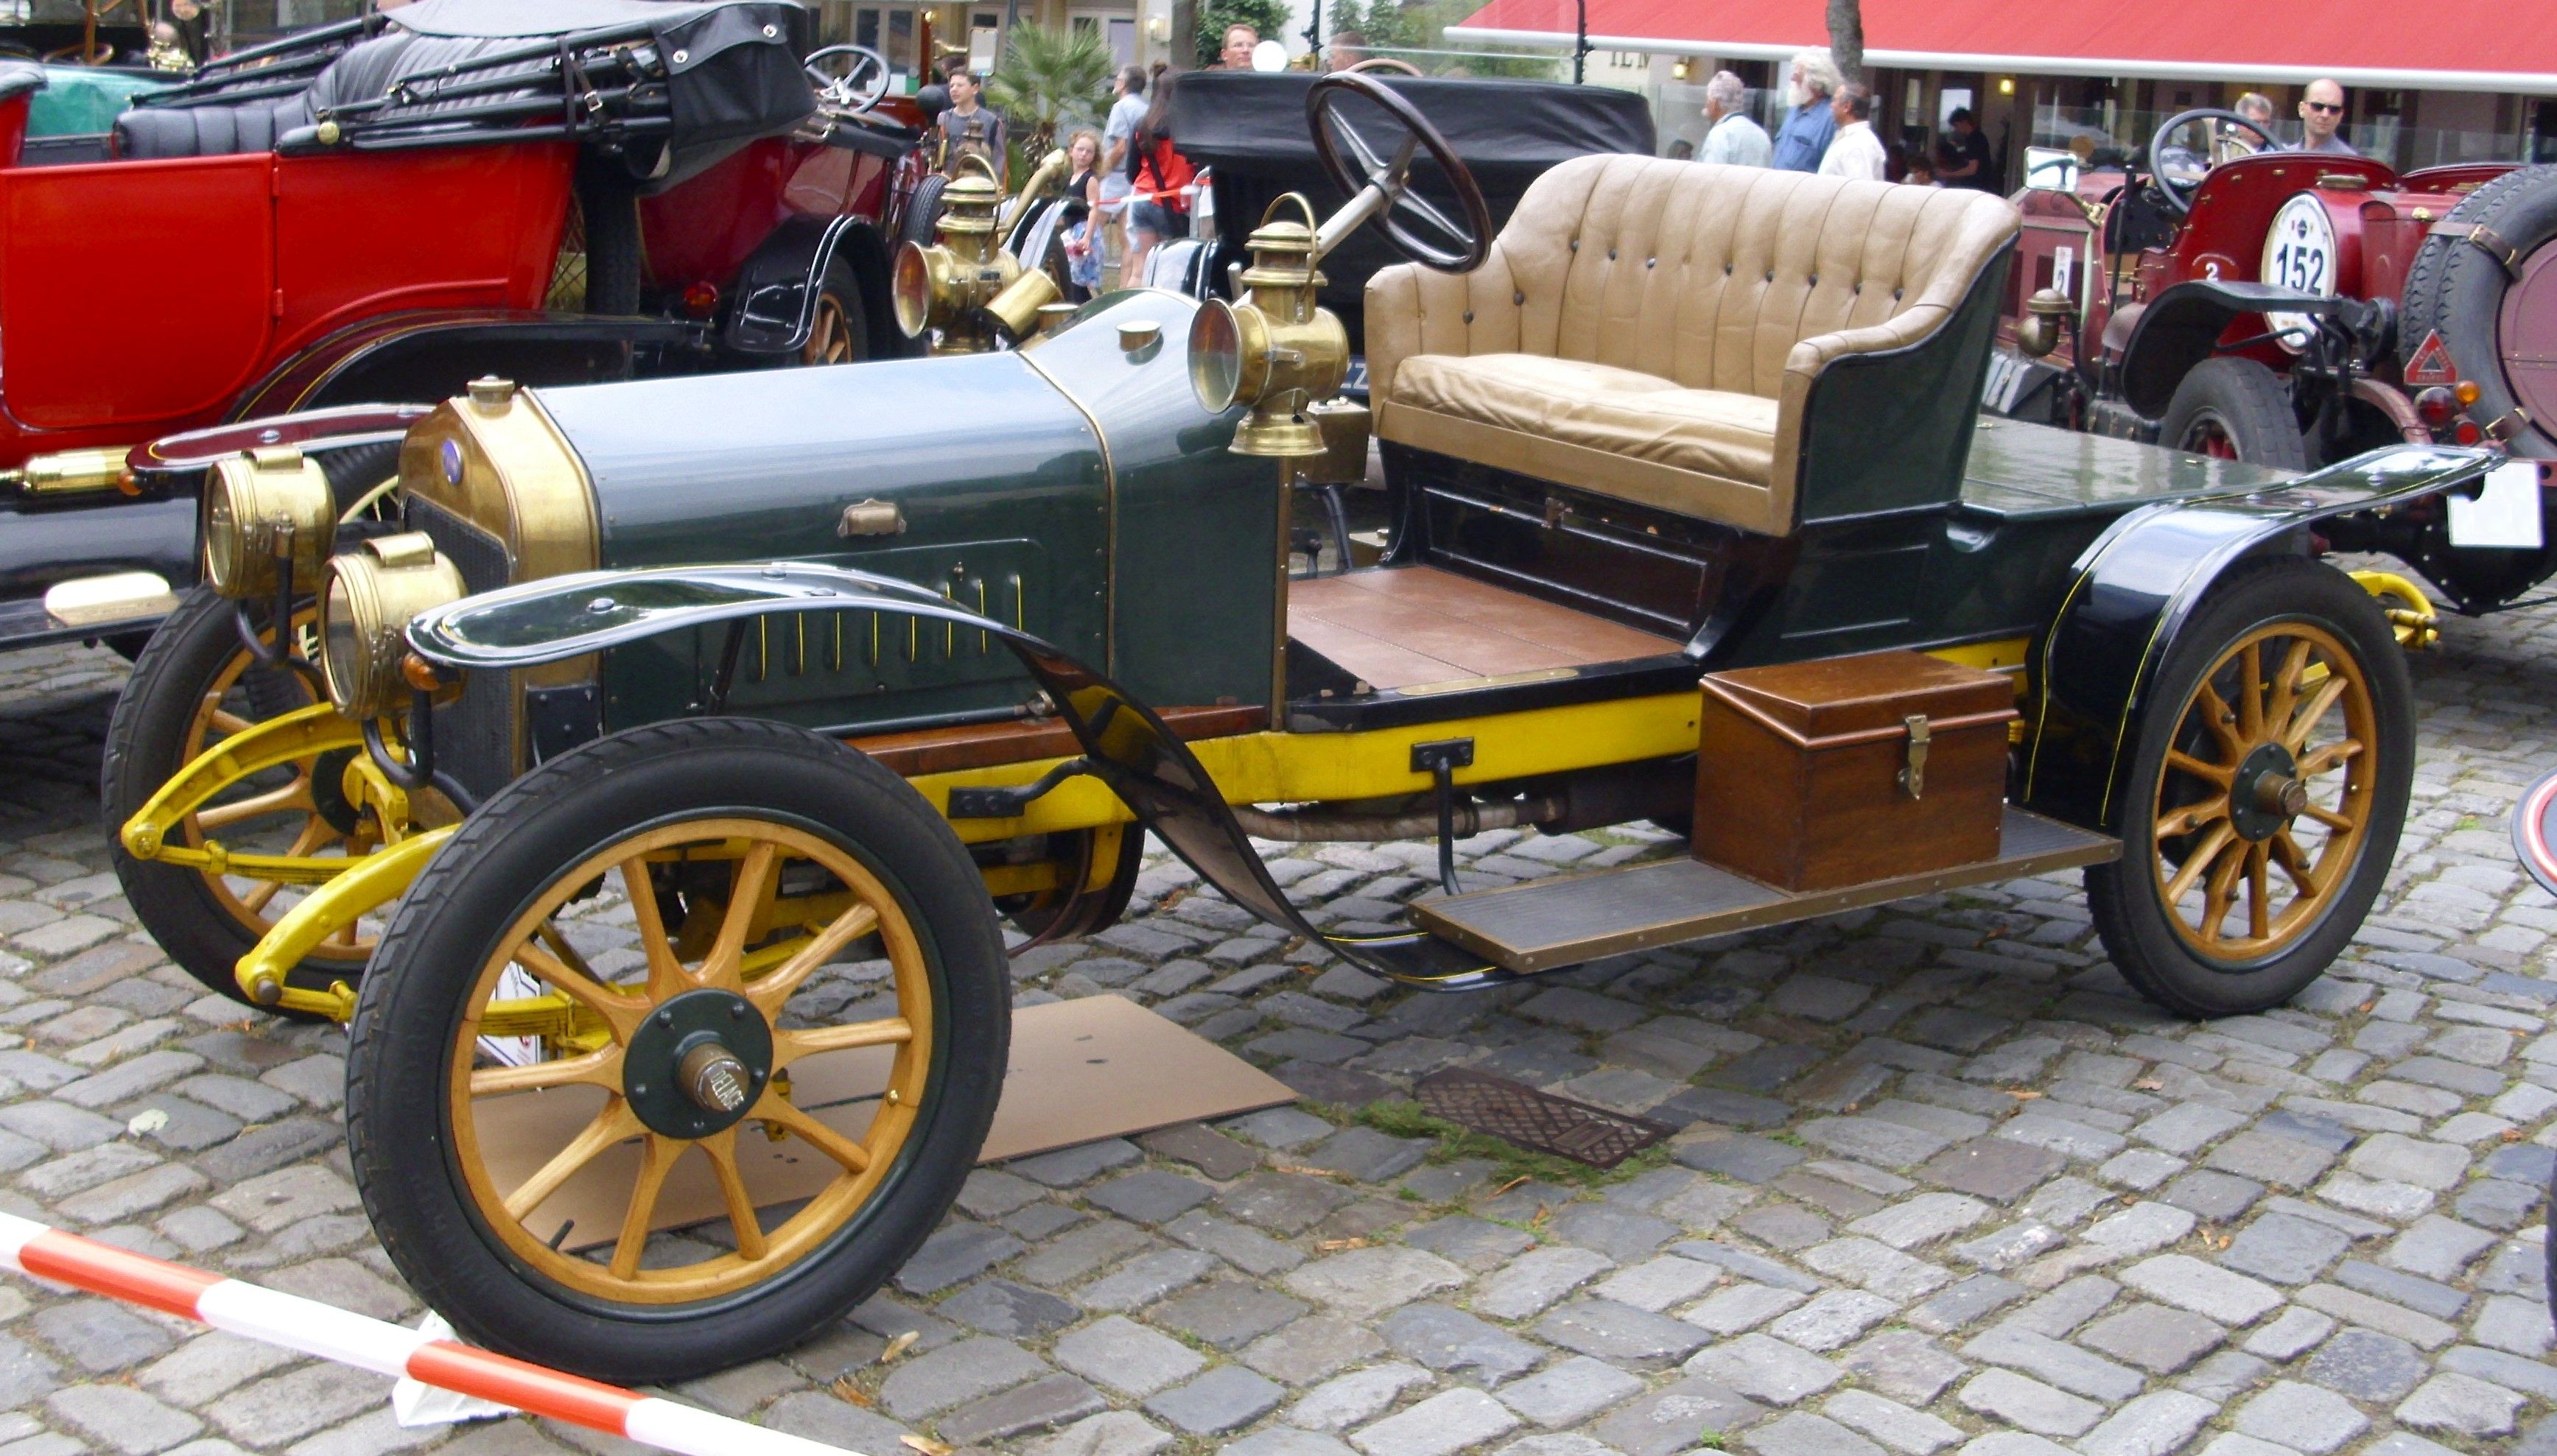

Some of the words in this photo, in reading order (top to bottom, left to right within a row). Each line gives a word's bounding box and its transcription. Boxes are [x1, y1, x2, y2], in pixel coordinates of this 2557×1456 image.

[2206, 262, 2218, 281] 2
[2276, 244, 2323, 295] 152
[710, 1070, 744, 1111] DELAGE
